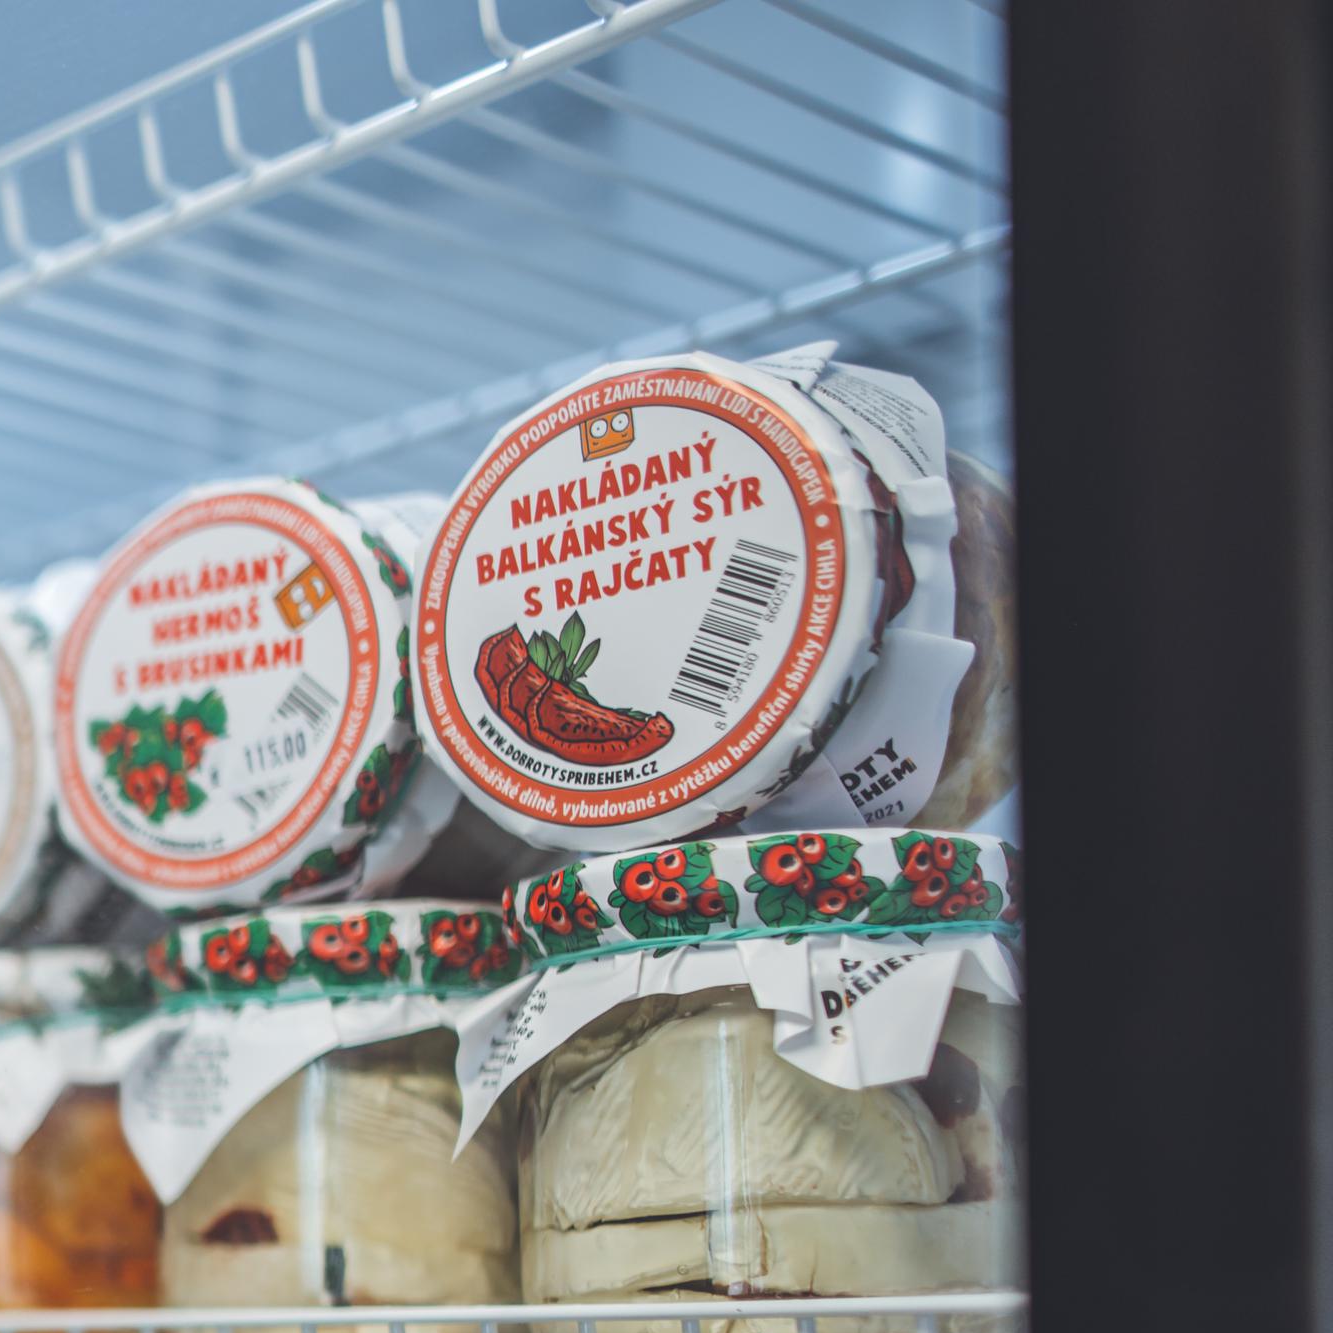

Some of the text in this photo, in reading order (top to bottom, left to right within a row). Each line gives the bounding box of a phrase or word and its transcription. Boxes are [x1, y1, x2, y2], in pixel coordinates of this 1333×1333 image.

[424, 506, 474, 609] ZAKOUPENÍM
[462, 440, 523, 509] VÝROBKU
[516, 388, 601, 451] PODPOŘÍTE
[601, 376, 723, 409] ZAMĚSTNÁVÁNÍ
[746, 404, 765, 425] S
[756, 413, 826, 505] HANDICAPEM
[510, 430, 717, 529] NAKLÁDANÝ
[476, 473, 764, 586] BALKÁNSKÝ SÝR
[129, 544, 288, 607] NAKLÁDANÝ
[523, 536, 717, 617] S RAJČATY
[814, 538, 836, 590] CIHLA
[153, 596, 261, 643] HERMOŠ
[804, 593, 833, 636] AKCE
[137, 636, 304, 690] BRUSINKAMI
[421, 642, 450, 716] Vyrobeno
[781, 636, 825, 694] sbírky
[438, 713, 453, 728] v
[725, 687, 793, 761] benefiční
[516, 786, 560, 816] dílně,
[657, 791, 670, 805] z
[668, 751, 734, 803] výtěžku
[559, 790, 657, 821] vybudované
